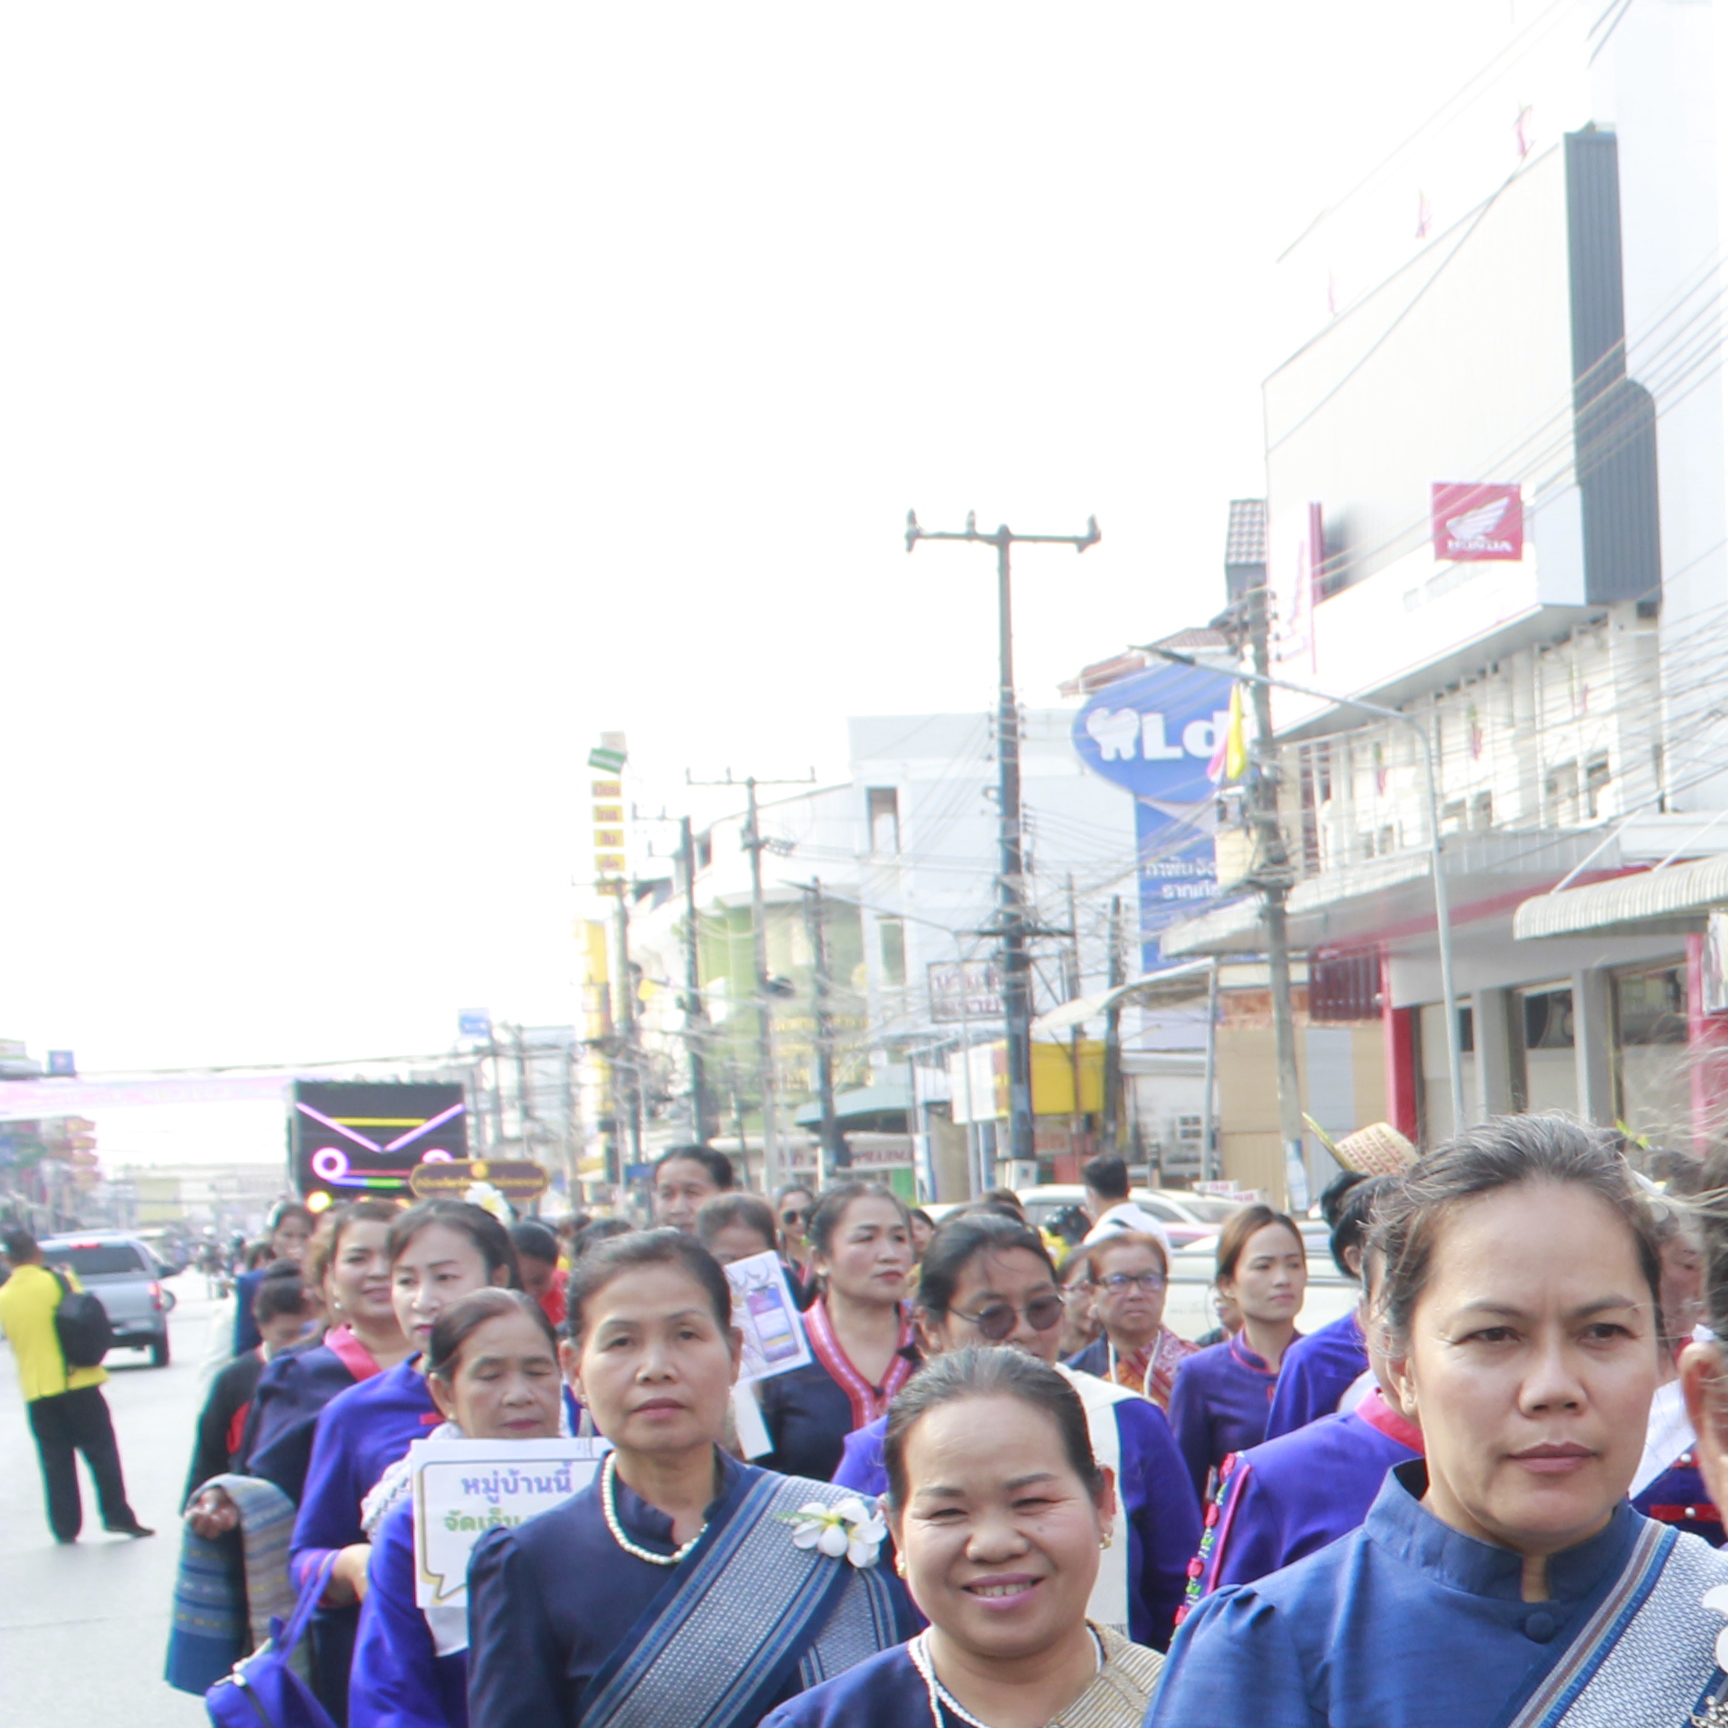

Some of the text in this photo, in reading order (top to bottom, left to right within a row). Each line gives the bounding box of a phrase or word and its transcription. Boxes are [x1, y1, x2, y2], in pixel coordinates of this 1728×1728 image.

[1446, 539, 1514, 552] HONDA
[1142, 711, 1230, 760] Ld
[461, 1460, 573, 1504] หมู่บ้านนี้
